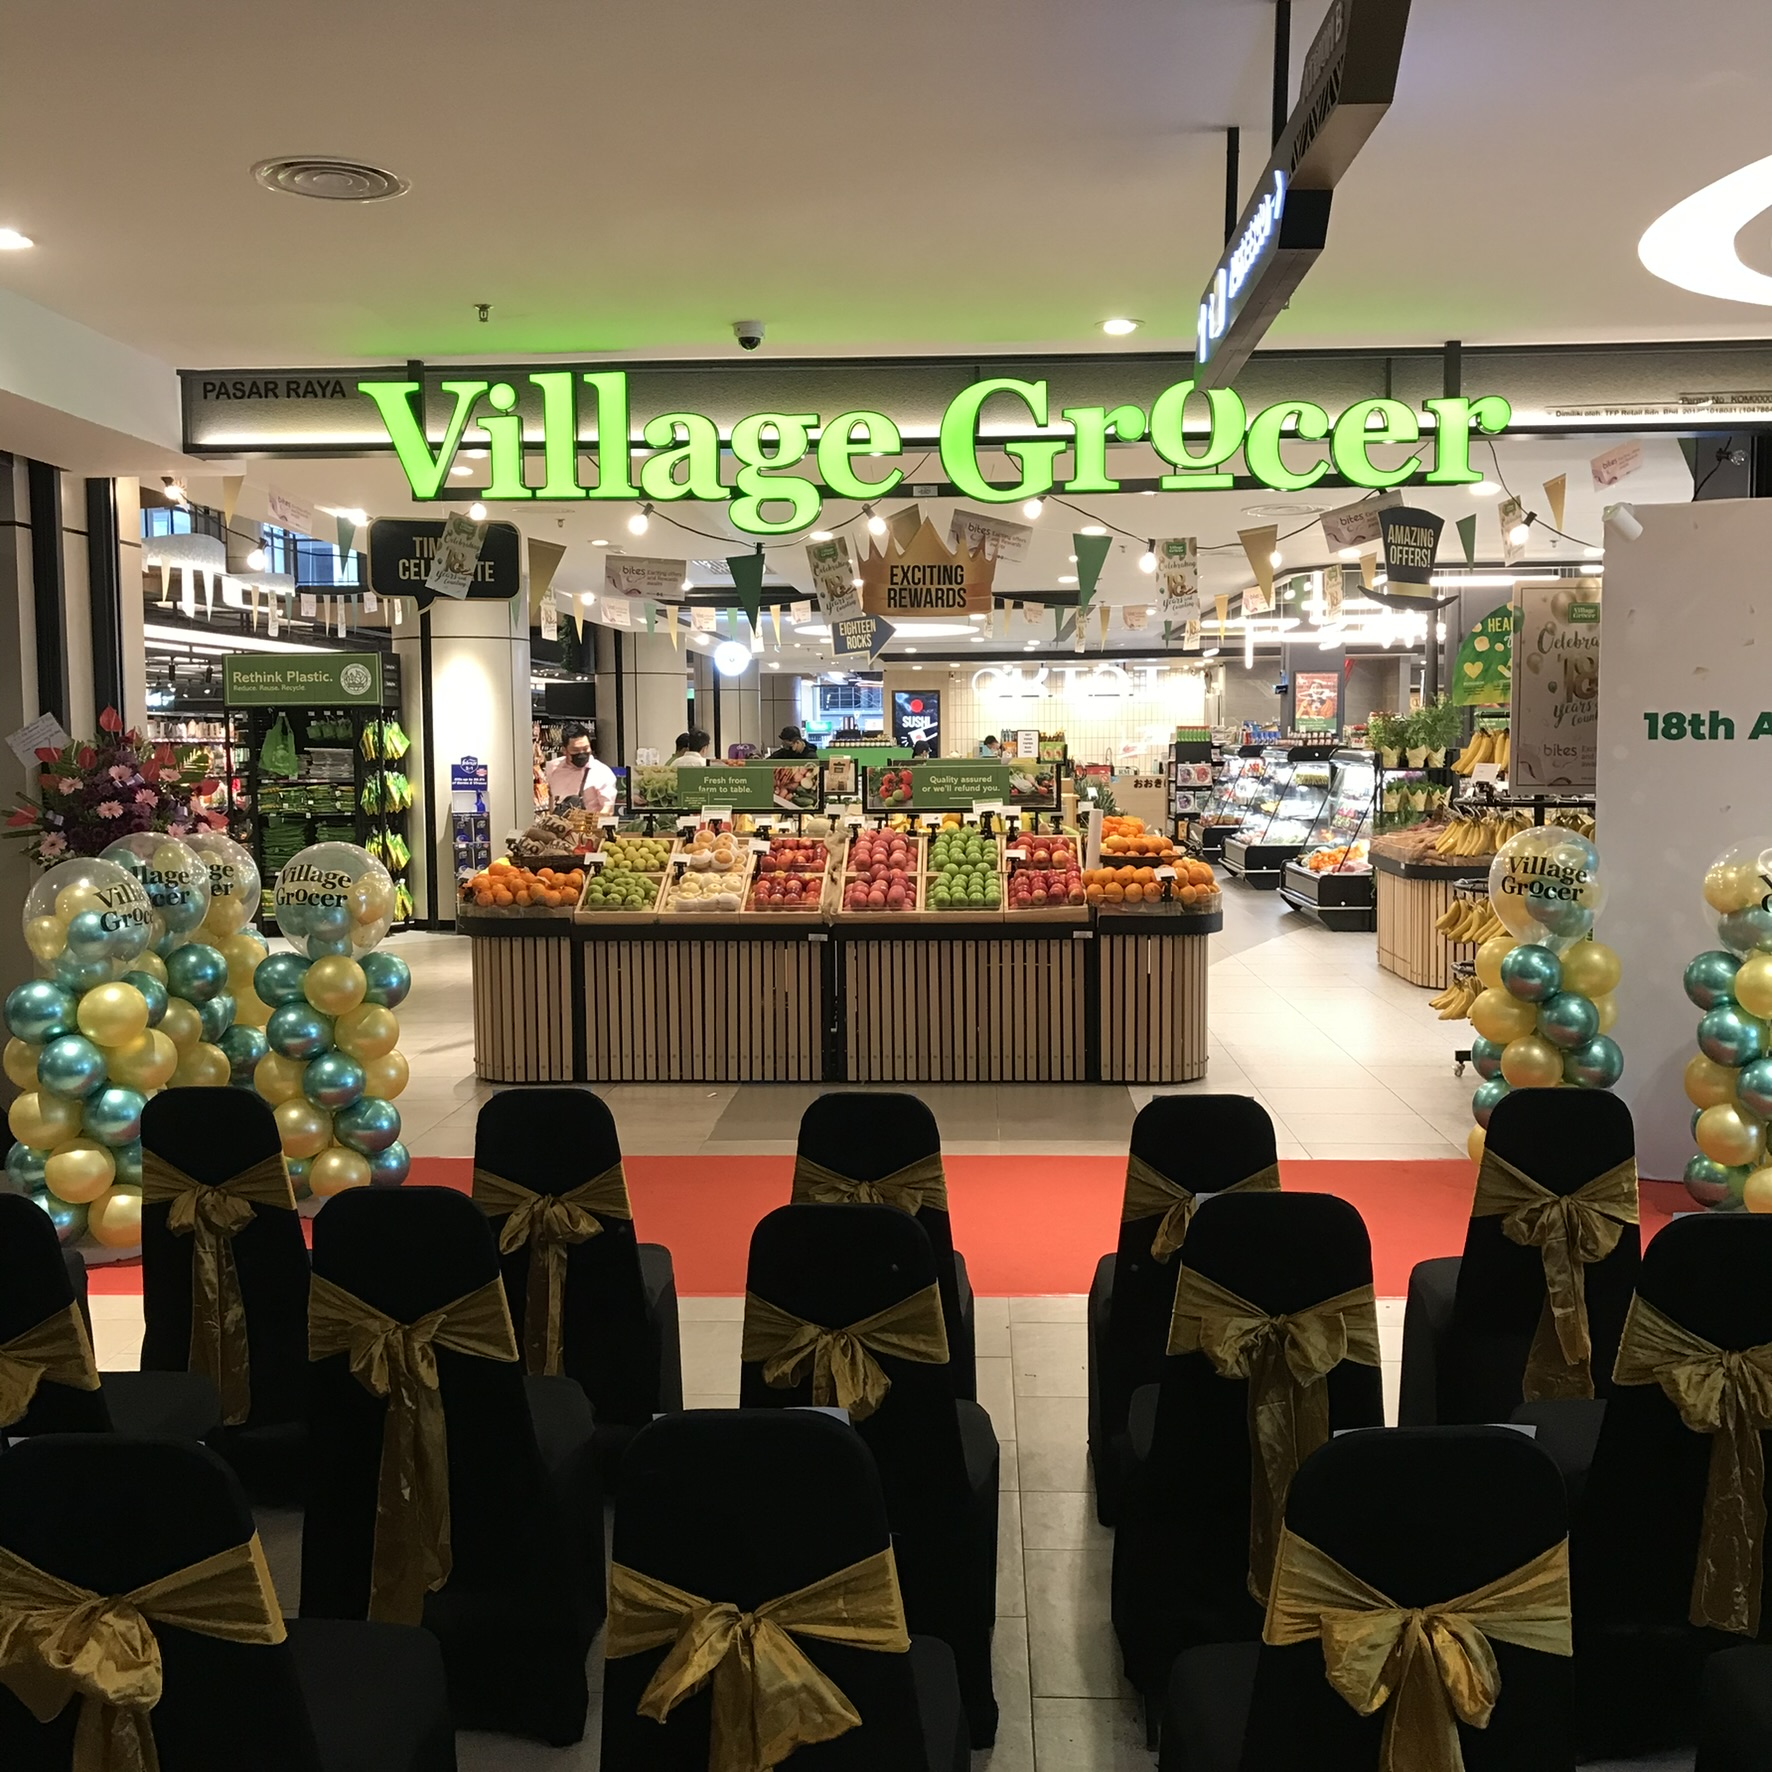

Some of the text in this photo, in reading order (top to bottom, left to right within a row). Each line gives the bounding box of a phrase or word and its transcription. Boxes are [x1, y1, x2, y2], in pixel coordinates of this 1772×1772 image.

[202, 380, 346, 400] PASAR RAYA
[356, 371, 1513, 534] Village Grocer
[1340, 513, 1364, 526] bites
[968, 522, 991, 536] bites
[1387, 524, 1434, 547] AMAZING
[1389, 545, 1432, 568] OFFERS!
[622, 565, 646, 576] bites
[890, 565, 964, 585] EXCITING
[887, 588, 966, 608] REWARDS
[839, 619, 877, 636] EIGHTEEN
[846, 634, 872, 650] ROCKS
[233, 671, 333, 683] Rethink Plastic.
[902, 715, 931, 728] SUSHI
[1643, 710, 1735, 740] 18th
[1543, 744, 1578, 757] bites
[703, 776, 748, 784] Fresh from
[929, 775, 992, 785] Quality assured
[698, 785, 717, 793] farm
[730, 785, 753, 793] table.
[954, 784, 980, 792] refund
[982, 785, 1001, 794] you.
[281, 863, 351, 889] Village
[1509, 856, 1588, 885] Village
[1501, 875, 1584, 902] Grocer
[276, 888, 348, 908] Grocer
